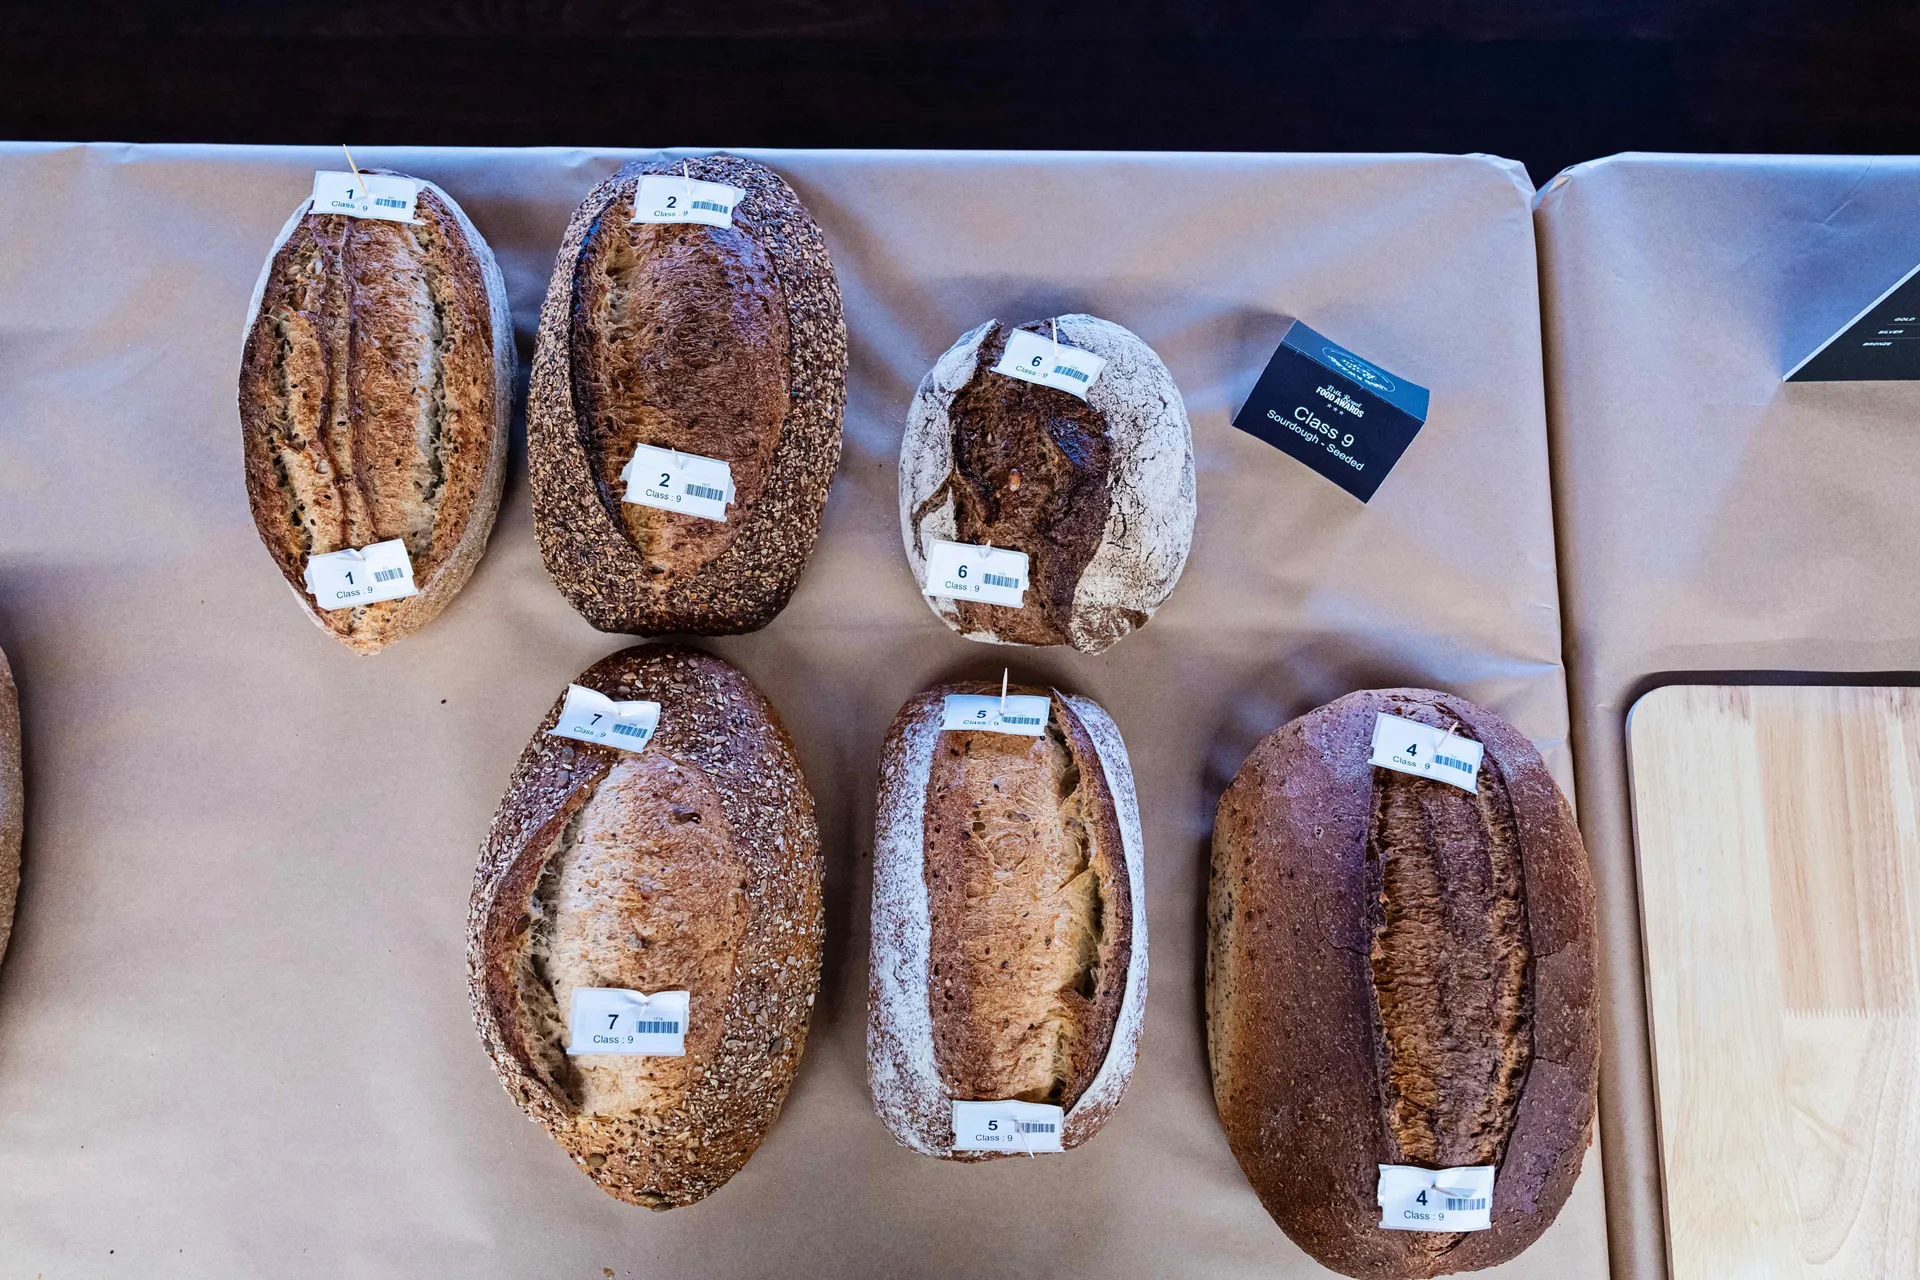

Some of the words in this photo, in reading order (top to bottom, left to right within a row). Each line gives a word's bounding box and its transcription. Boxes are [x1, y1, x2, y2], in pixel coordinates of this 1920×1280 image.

[346, 189, 354, 199] 1
[331, 201, 355, 209] Class
[667, 197, 677, 208] 2
[1032, 356, 1042, 366] 6
[1016, 365, 1036, 376] Class
[1316, 386, 1335, 401] FOOD
[1334, 398, 1364, 418] AWARDS
[1294, 406, 1339, 440] Class
[1341, 434, 1354, 448] 9
[1267, 409, 1319, 444] Sourdough
[1327, 444, 1364, 471] Seeded
[659, 473, 670, 487] 2
[646, 489, 669, 500] Class
[958, 565, 967, 578] 6
[345, 572, 354, 584] 1
[945, 581, 967, 590] Class
[336, 591, 360, 599] Class
[590, 714, 602, 725] 7
[573, 726, 594, 736] Class
[1406, 744, 1417, 757] 4
[1393, 756, 1416, 767] Class
[608, 1015, 619, 1029] 7
[593, 1035, 619, 1044] Class
[627, 1036, 634, 1044] 9
[988, 1120, 998, 1130] 5
[1416, 1190, 1428, 1206] 4
[1404, 1211, 1430, 1220] Class
[1438, 1213, 1444, 1221] 9
